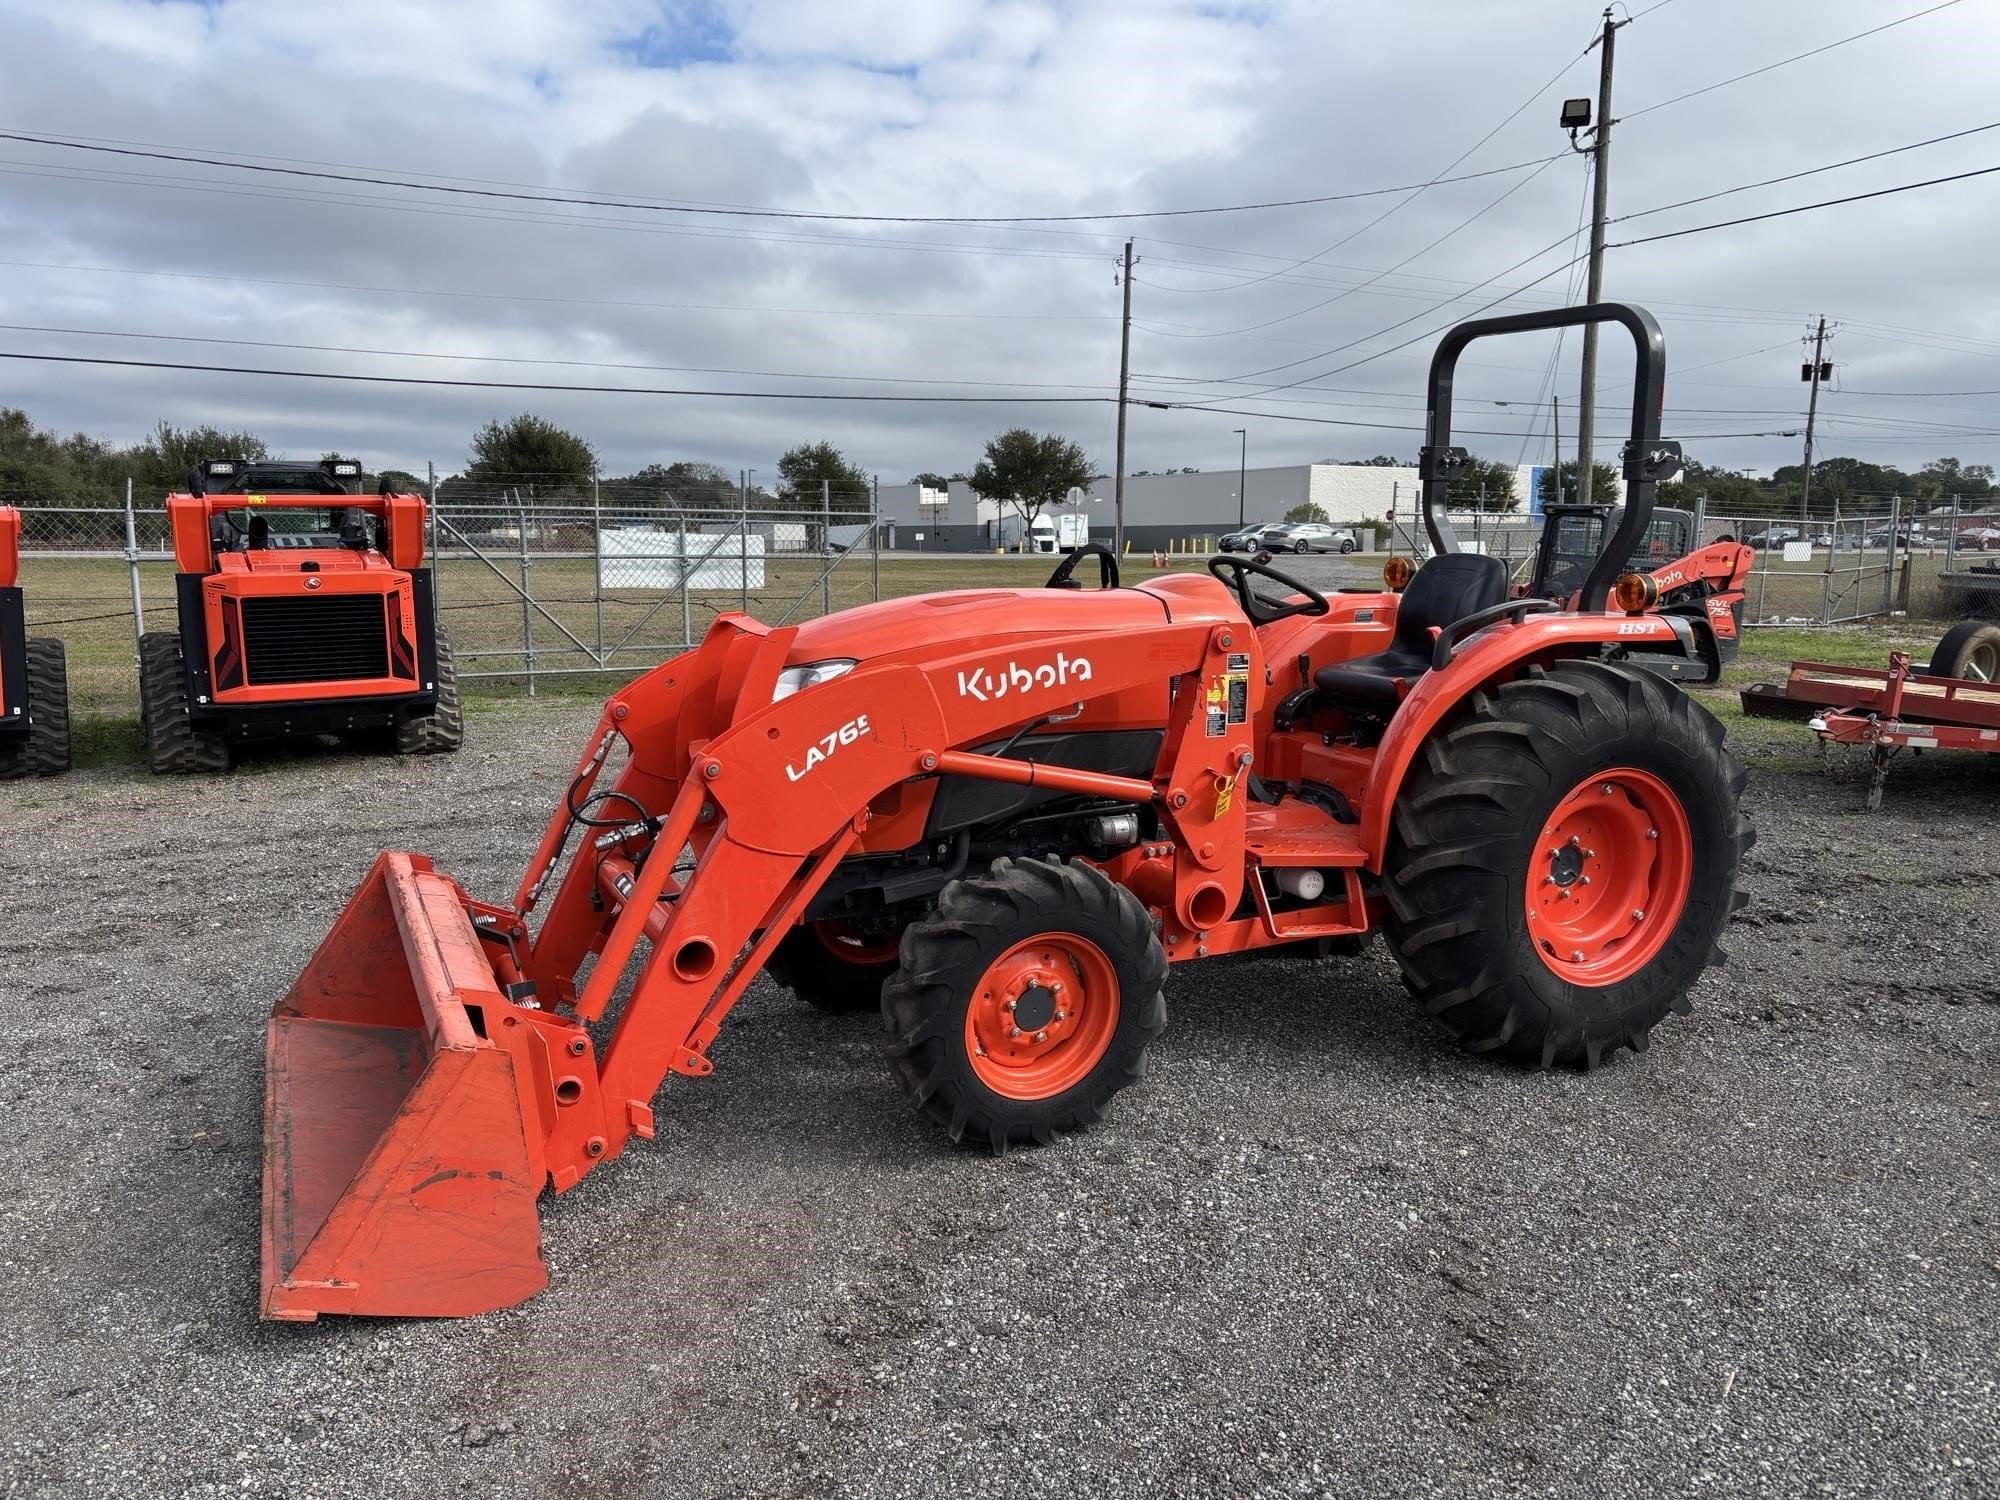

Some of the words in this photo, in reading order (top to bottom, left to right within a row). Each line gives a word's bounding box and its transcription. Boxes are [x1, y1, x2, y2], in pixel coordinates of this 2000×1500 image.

[1656, 570, 1683, 588] bota
[1707, 599, 1731, 608] SVL
[1617, 623, 1658, 635] HST
[957, 652, 1092, 702] Kubota
